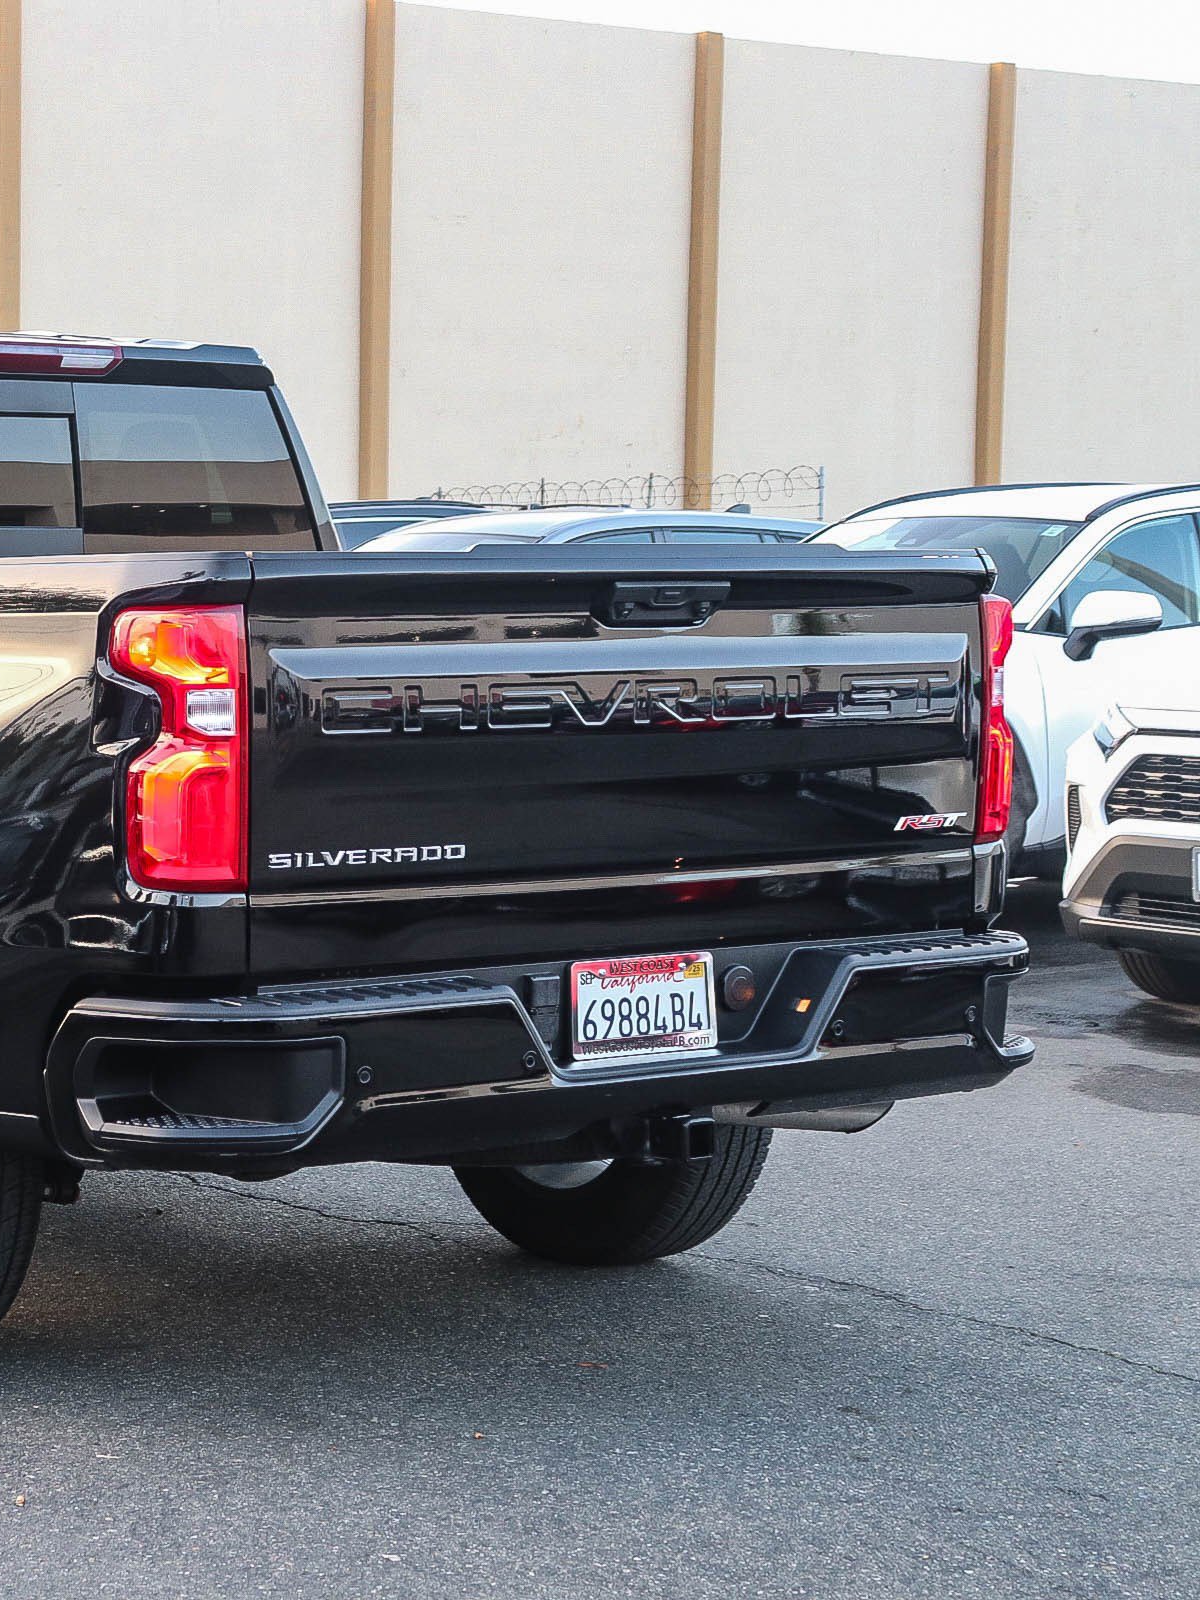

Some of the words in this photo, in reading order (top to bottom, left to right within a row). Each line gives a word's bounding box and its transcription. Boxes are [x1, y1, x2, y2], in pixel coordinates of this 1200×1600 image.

[320, 671, 952, 736] CHEVROLET
[894, 812, 968, 831] RST
[268, 844, 466, 868] SILVERADO
[582, 991, 703, 1041] 69884B4
